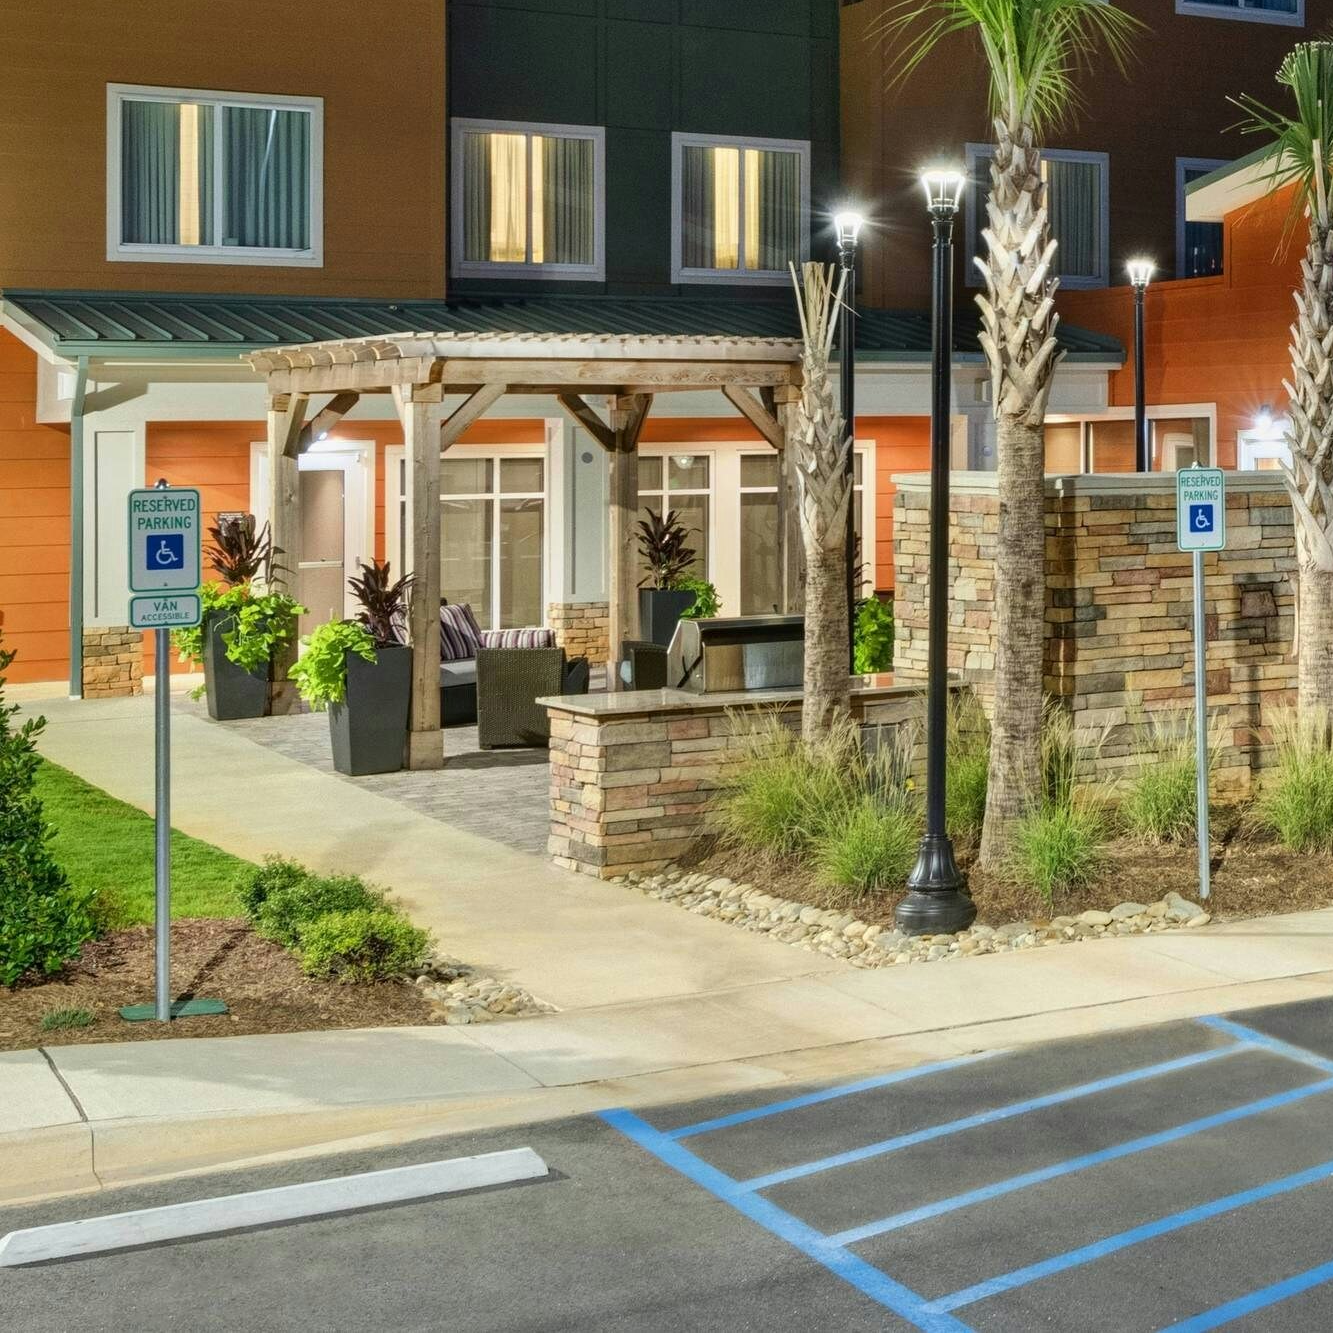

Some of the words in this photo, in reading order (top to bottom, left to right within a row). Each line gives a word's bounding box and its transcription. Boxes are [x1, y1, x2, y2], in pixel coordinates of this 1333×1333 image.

[1181, 476, 1220, 487] RESERVED
[1184, 490, 1218, 501] PARKING
[133, 498, 196, 513] RESERVED
[138, 516, 192, 530] PARKING
[153, 601, 178, 612] VAN
[141, 611, 190, 622] ACCESSIBLE
